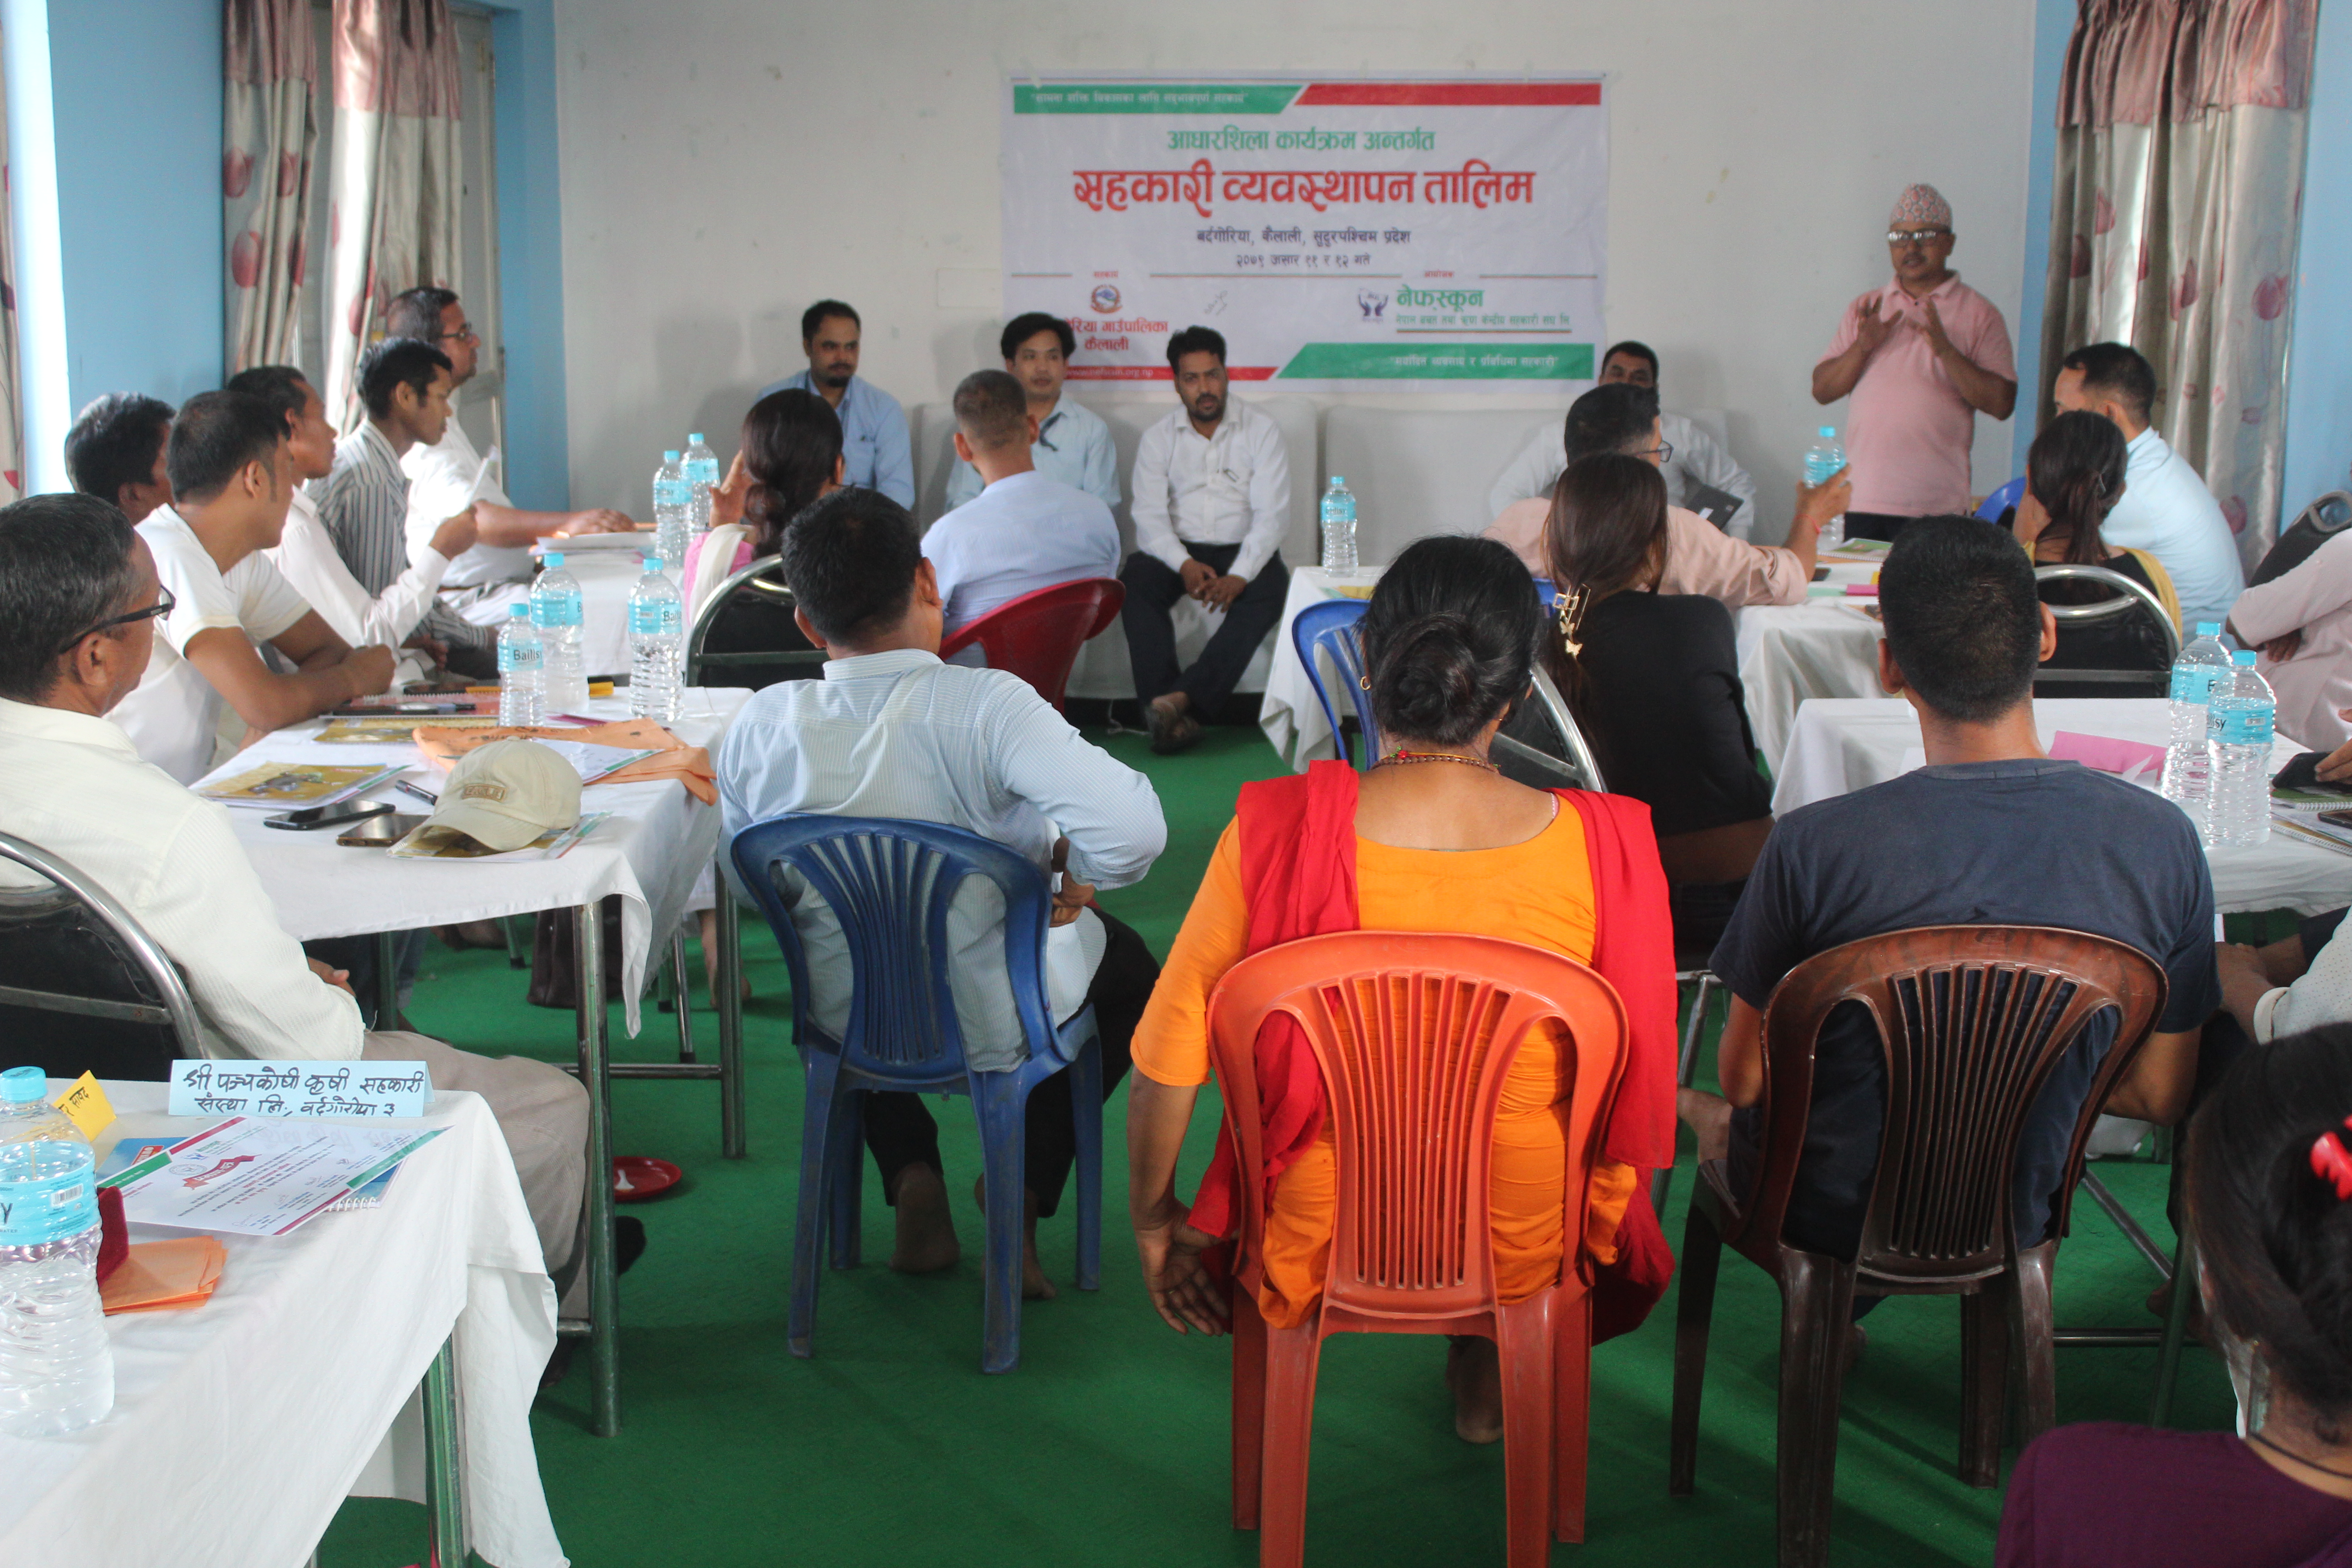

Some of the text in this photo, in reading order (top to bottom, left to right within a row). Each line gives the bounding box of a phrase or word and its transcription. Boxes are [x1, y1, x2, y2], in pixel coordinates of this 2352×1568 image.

[1168, 124, 1436, 151] आधारशिला कार्यक्रम अन्तर्गत
[1073, 158, 1537, 218] सहकारी व्यवस्थापन तालिम
[1384, 226, 1411, 244] प्रदेश
[359, 1070, 425, 1095] सहकारी
[383, 1102, 395, 1117] ३
